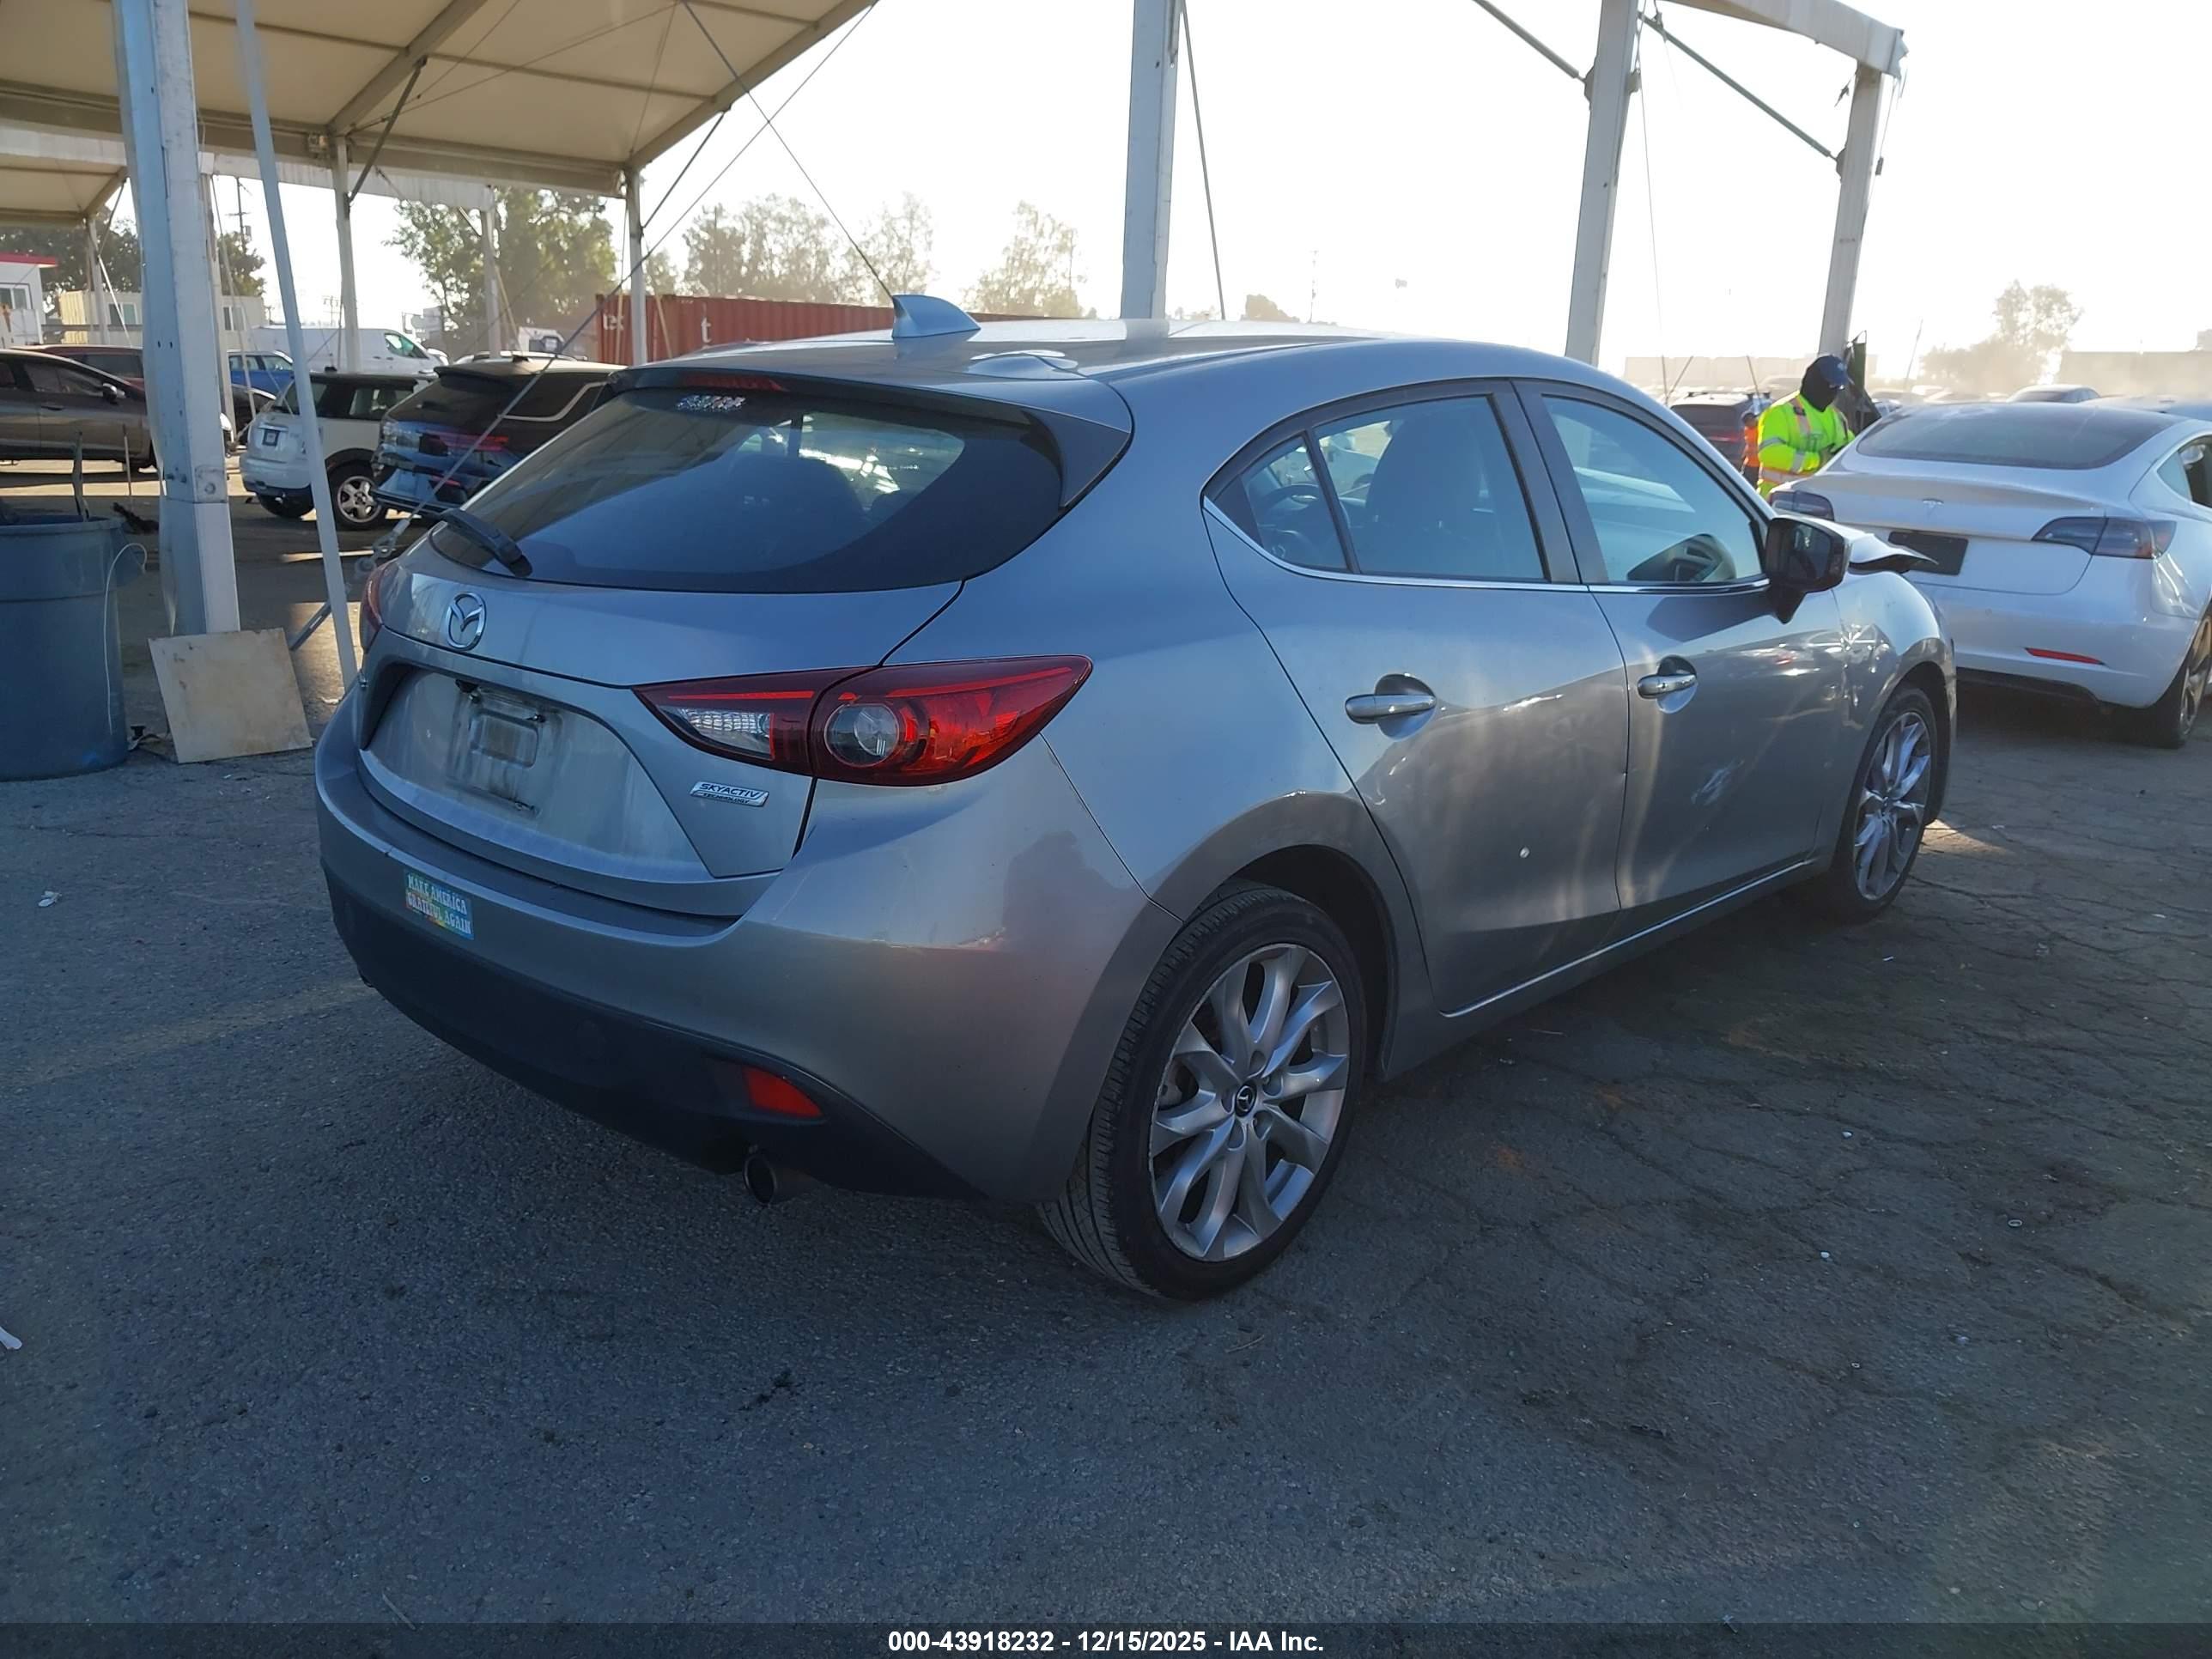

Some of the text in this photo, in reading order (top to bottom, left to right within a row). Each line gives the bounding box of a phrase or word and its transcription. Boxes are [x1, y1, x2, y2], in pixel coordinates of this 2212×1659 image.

[700, 783, 760, 798] SKYACTIV
[408, 873, 468, 915] MAKE AMERICA
[445, 910, 471, 935] AGAIN
